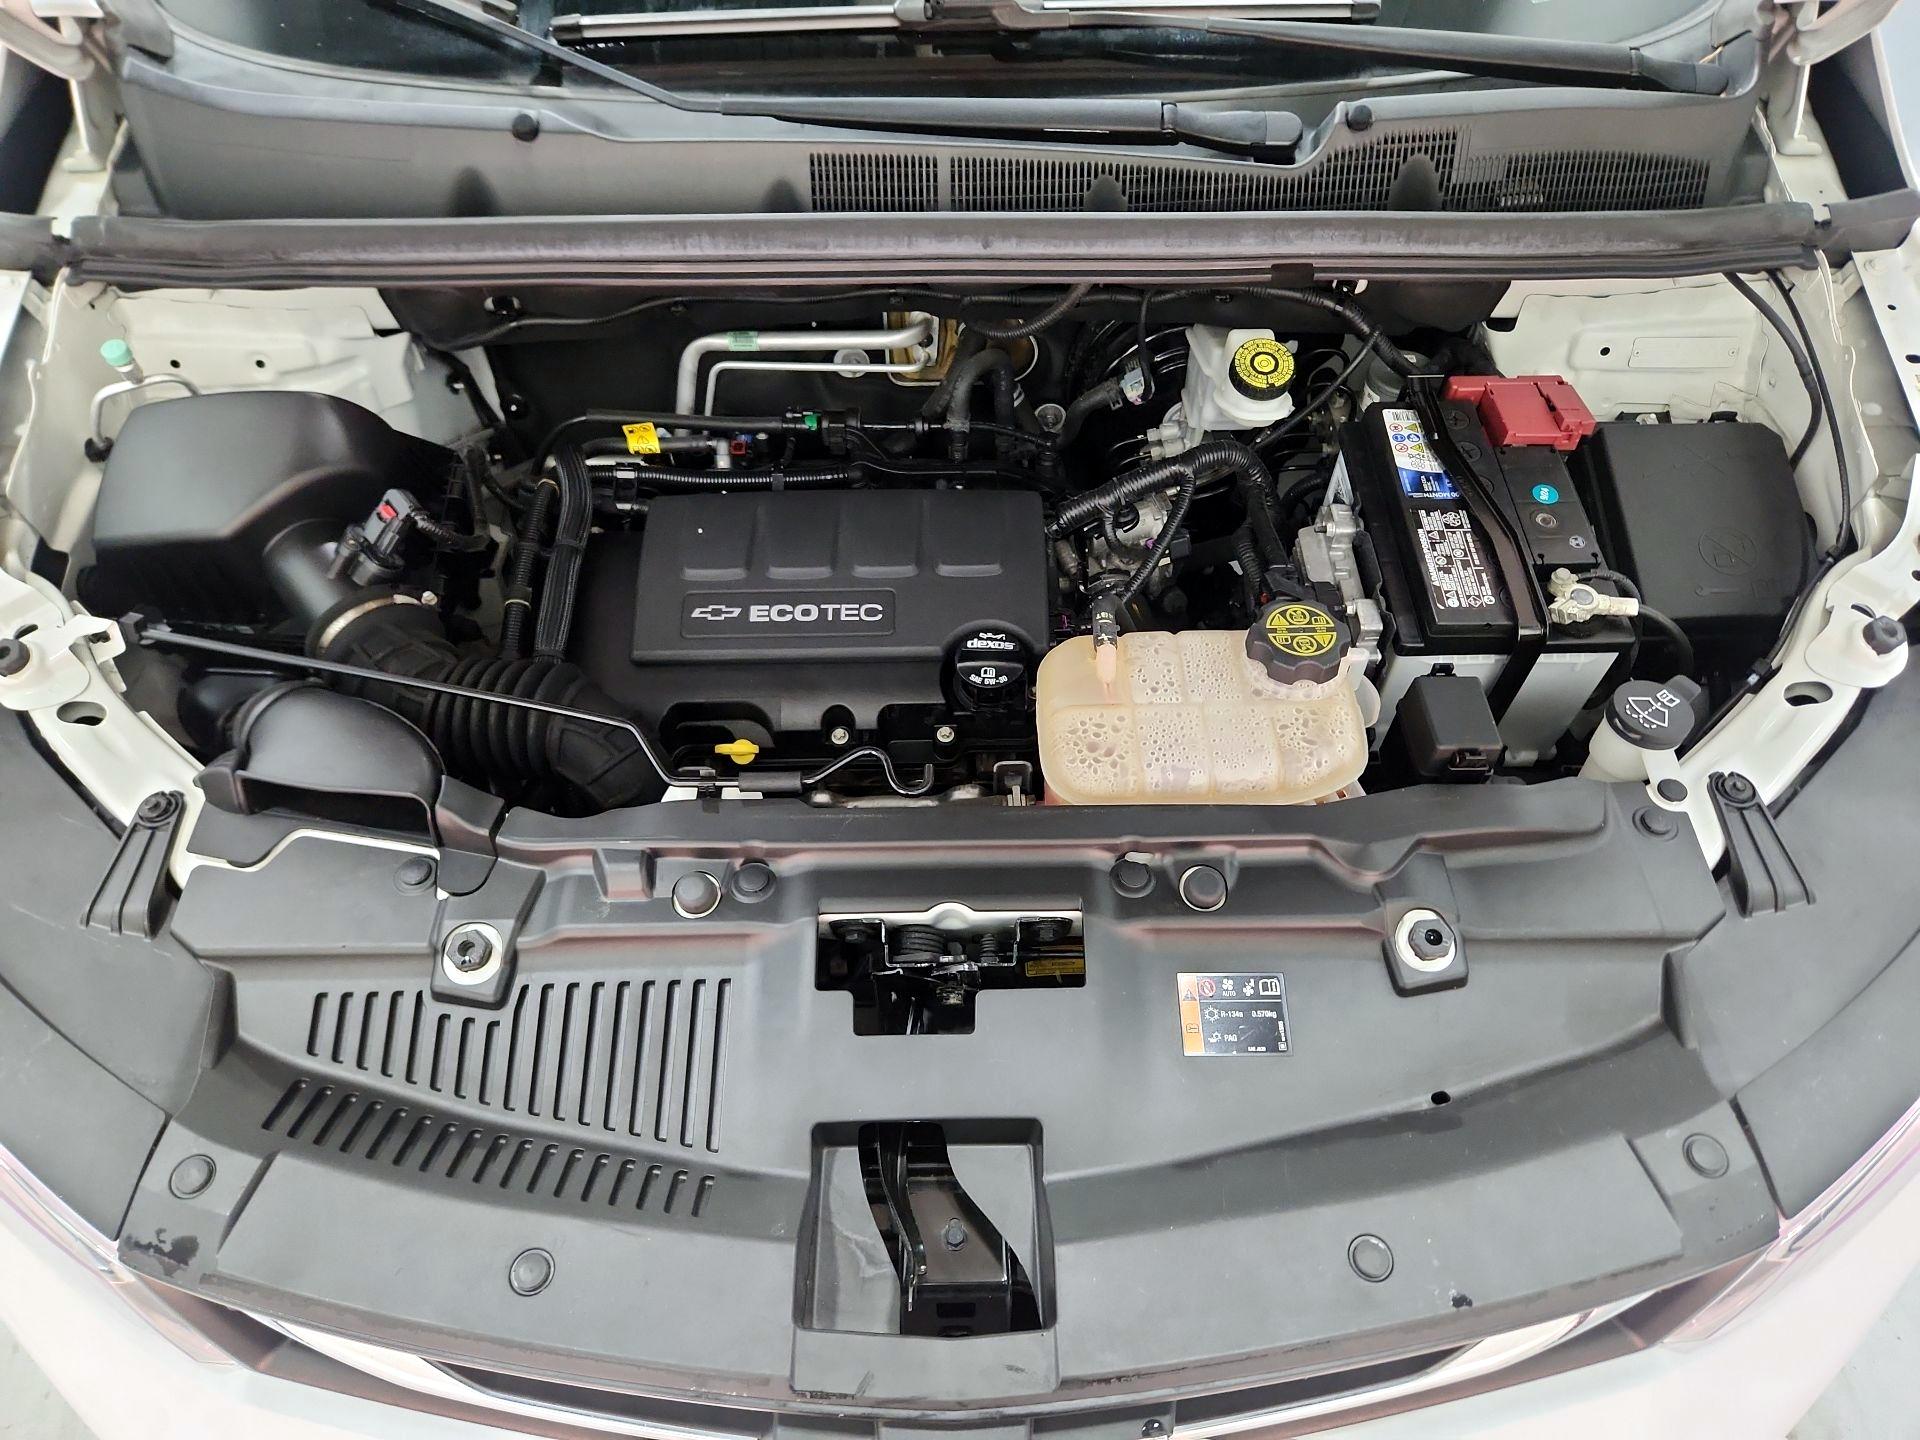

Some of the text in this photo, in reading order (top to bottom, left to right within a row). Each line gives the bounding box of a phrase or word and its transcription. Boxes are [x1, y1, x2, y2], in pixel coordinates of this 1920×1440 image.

[749, 603, 884, 623] ECOTEC
[967, 638, 1016, 650] dexos
[968, 674, 1009, 687] SAE 5W-30
[1221, 1010, 1277, 1019] R-134a 0.570kg
